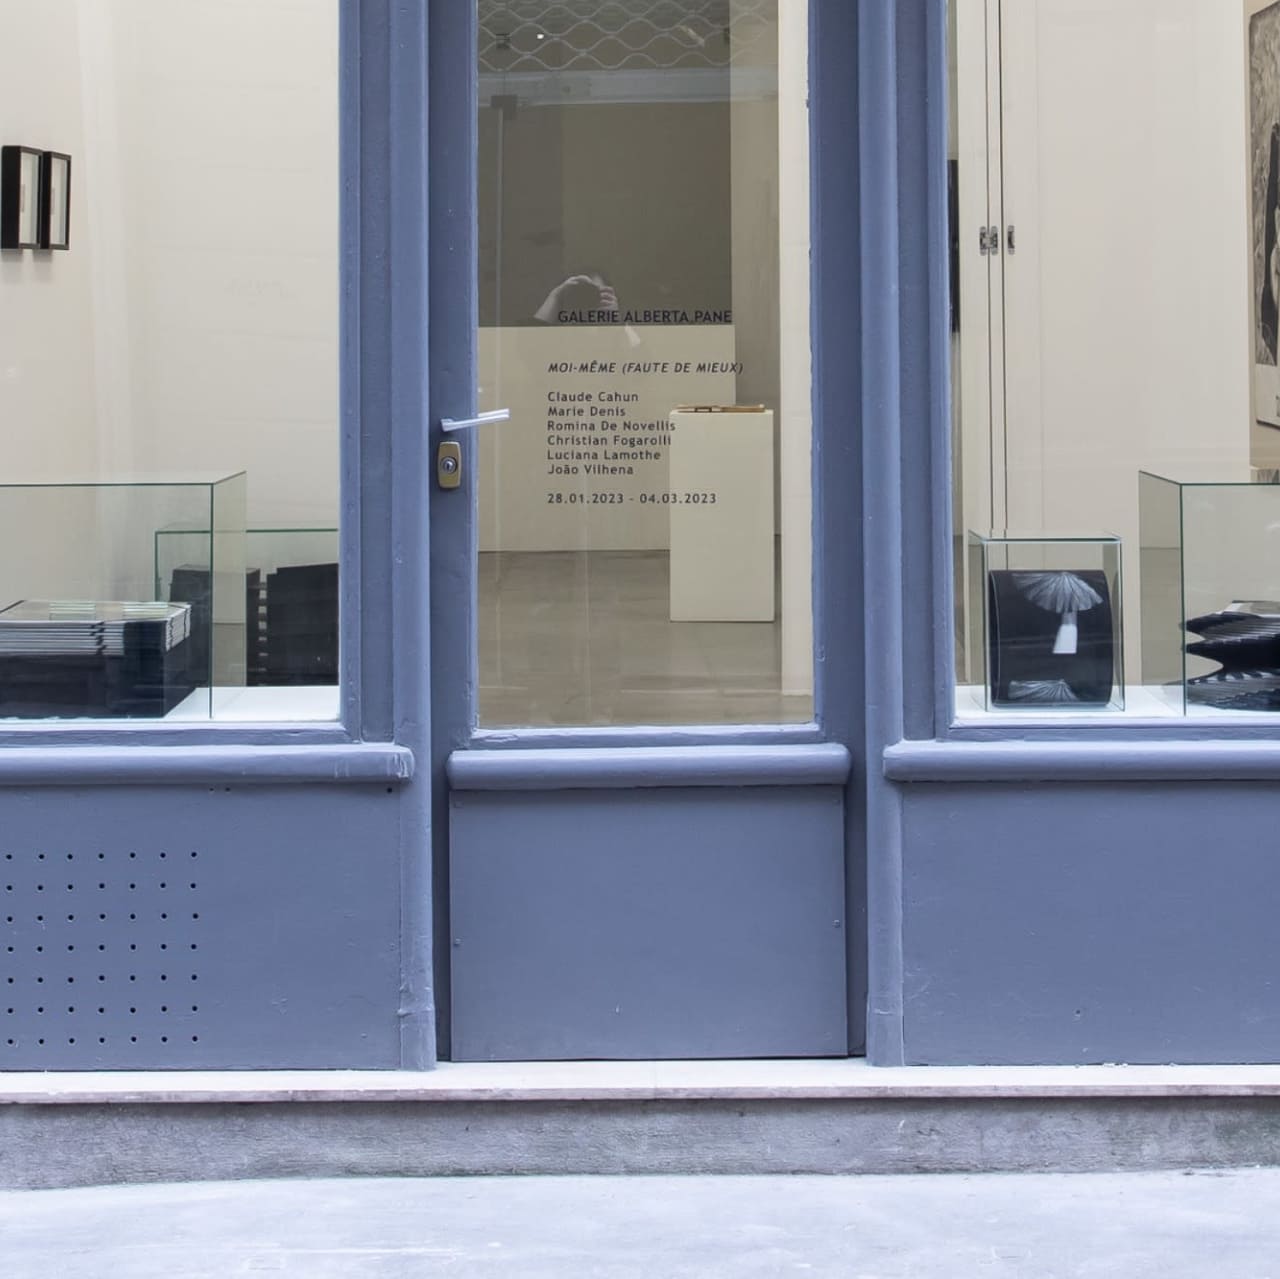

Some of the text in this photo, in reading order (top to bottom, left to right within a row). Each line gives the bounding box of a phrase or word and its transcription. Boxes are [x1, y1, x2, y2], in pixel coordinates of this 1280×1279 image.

[558, 310, 732, 323] GALERIE ALBERTA PANE
[547, 360, 744, 374] MOI-MÊME (FAUTE DE MIEUX)
[547, 392, 639, 402] Claude Cahun
[547, 406, 626, 417] Marie Denis
[547, 421, 676, 431] Romina De Novellis
[547, 435, 672, 448] Christian Fogarolli
[547, 450, 662, 460] Luciana Lamothe
[547, 464, 634, 475] João Vilhena
[547, 493, 625, 504] 28.01.2023
[639, 493, 717, 504] 04.03.2023
